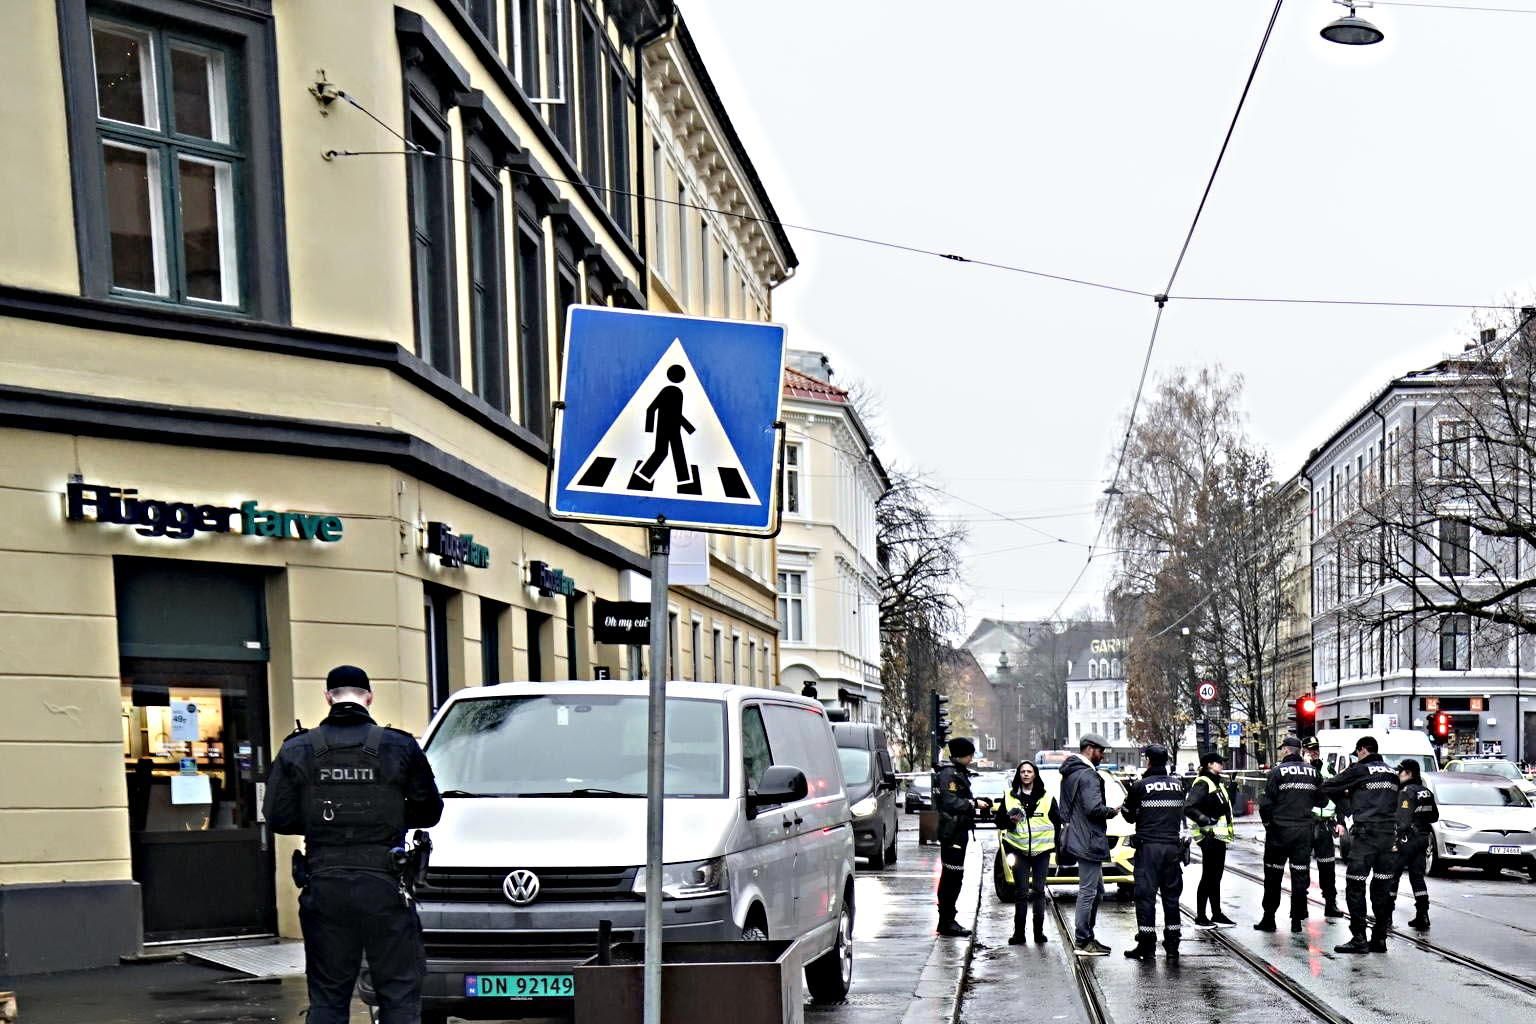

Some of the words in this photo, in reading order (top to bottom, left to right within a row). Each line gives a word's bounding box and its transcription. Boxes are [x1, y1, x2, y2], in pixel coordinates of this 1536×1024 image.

[1201, 687, 1213, 697] 40
[320, 768, 375, 781] POLITI
[1279, 765, 1317, 777] POLITI
[1145, 781, 1183, 794] POLITI
[481, 977, 507, 995] DN
[516, 976, 573, 995] 92149
